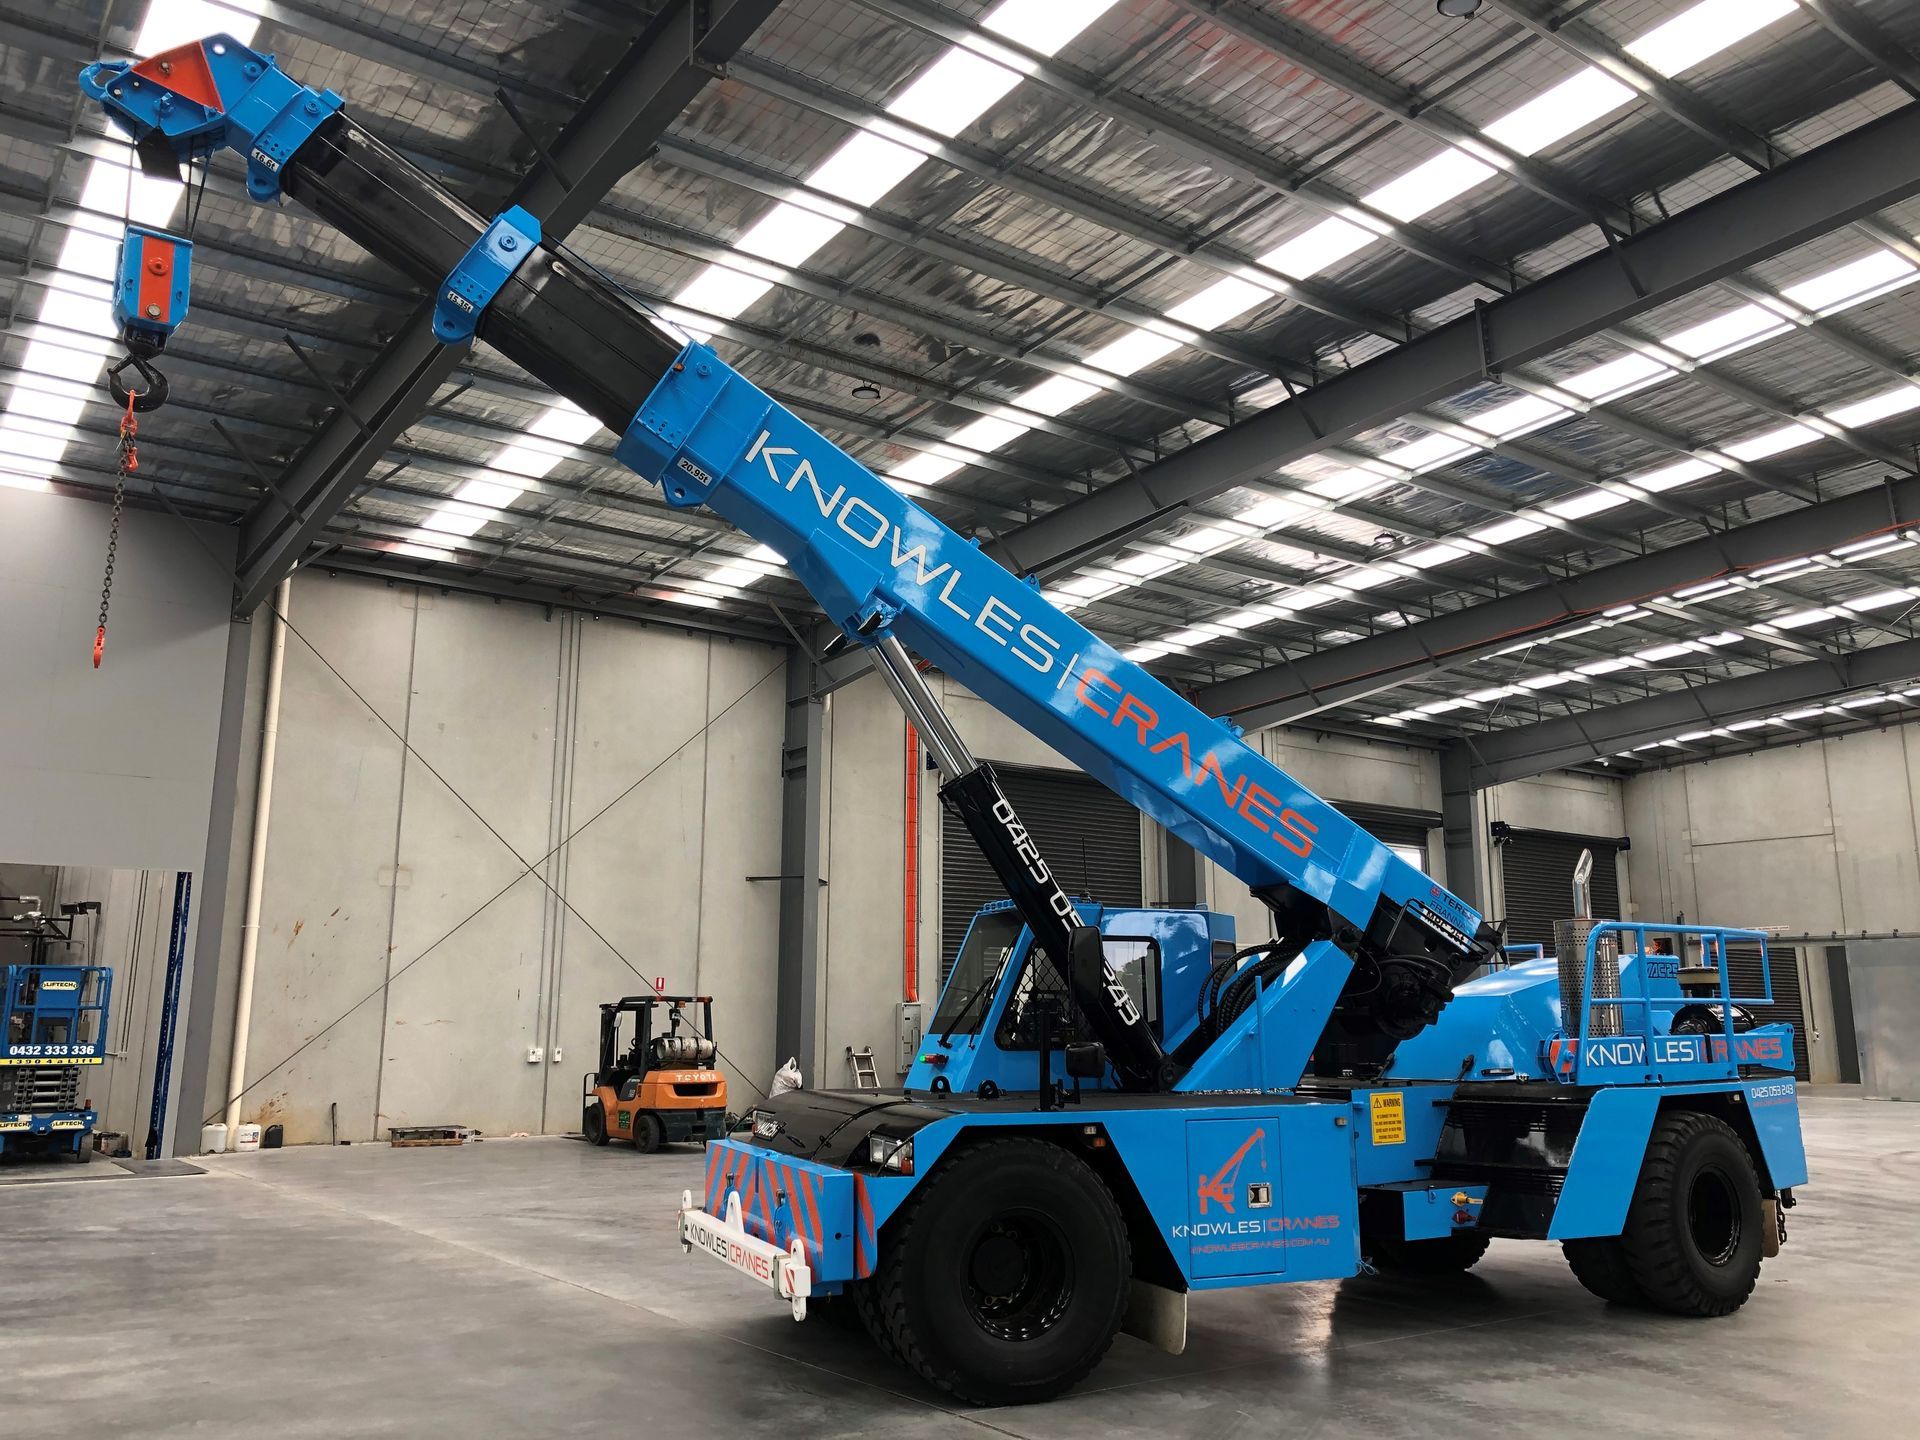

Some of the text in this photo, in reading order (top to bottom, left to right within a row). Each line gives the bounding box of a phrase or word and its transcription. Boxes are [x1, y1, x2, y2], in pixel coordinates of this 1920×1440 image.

[255, 151, 276, 170] 16.6t
[449, 293, 472, 312] 15.35t
[680, 460, 709, 484] 20.95t
[744, 429, 1319, 858] KNOWLES CRANES
[992, 799, 1049, 884] 0425
[1049, 889, 1086, 933] 05
[1428, 899, 1466, 930] FRANNA
[1442, 892, 1477, 922] TEREX
[9, 1045, 95, 1055] 0432 333 336
[1586, 1040, 1693, 1067] KNOWLES
[676, 1074, 716, 1082] TOYOTA
[1382, 1097, 1401, 1107] WARNING
[1751, 1087, 1768, 1098] 0425
[1172, 1215, 1340, 1238] KNOWLES CRANES
[690, 1222, 769, 1280] KNOWLES CRANES
